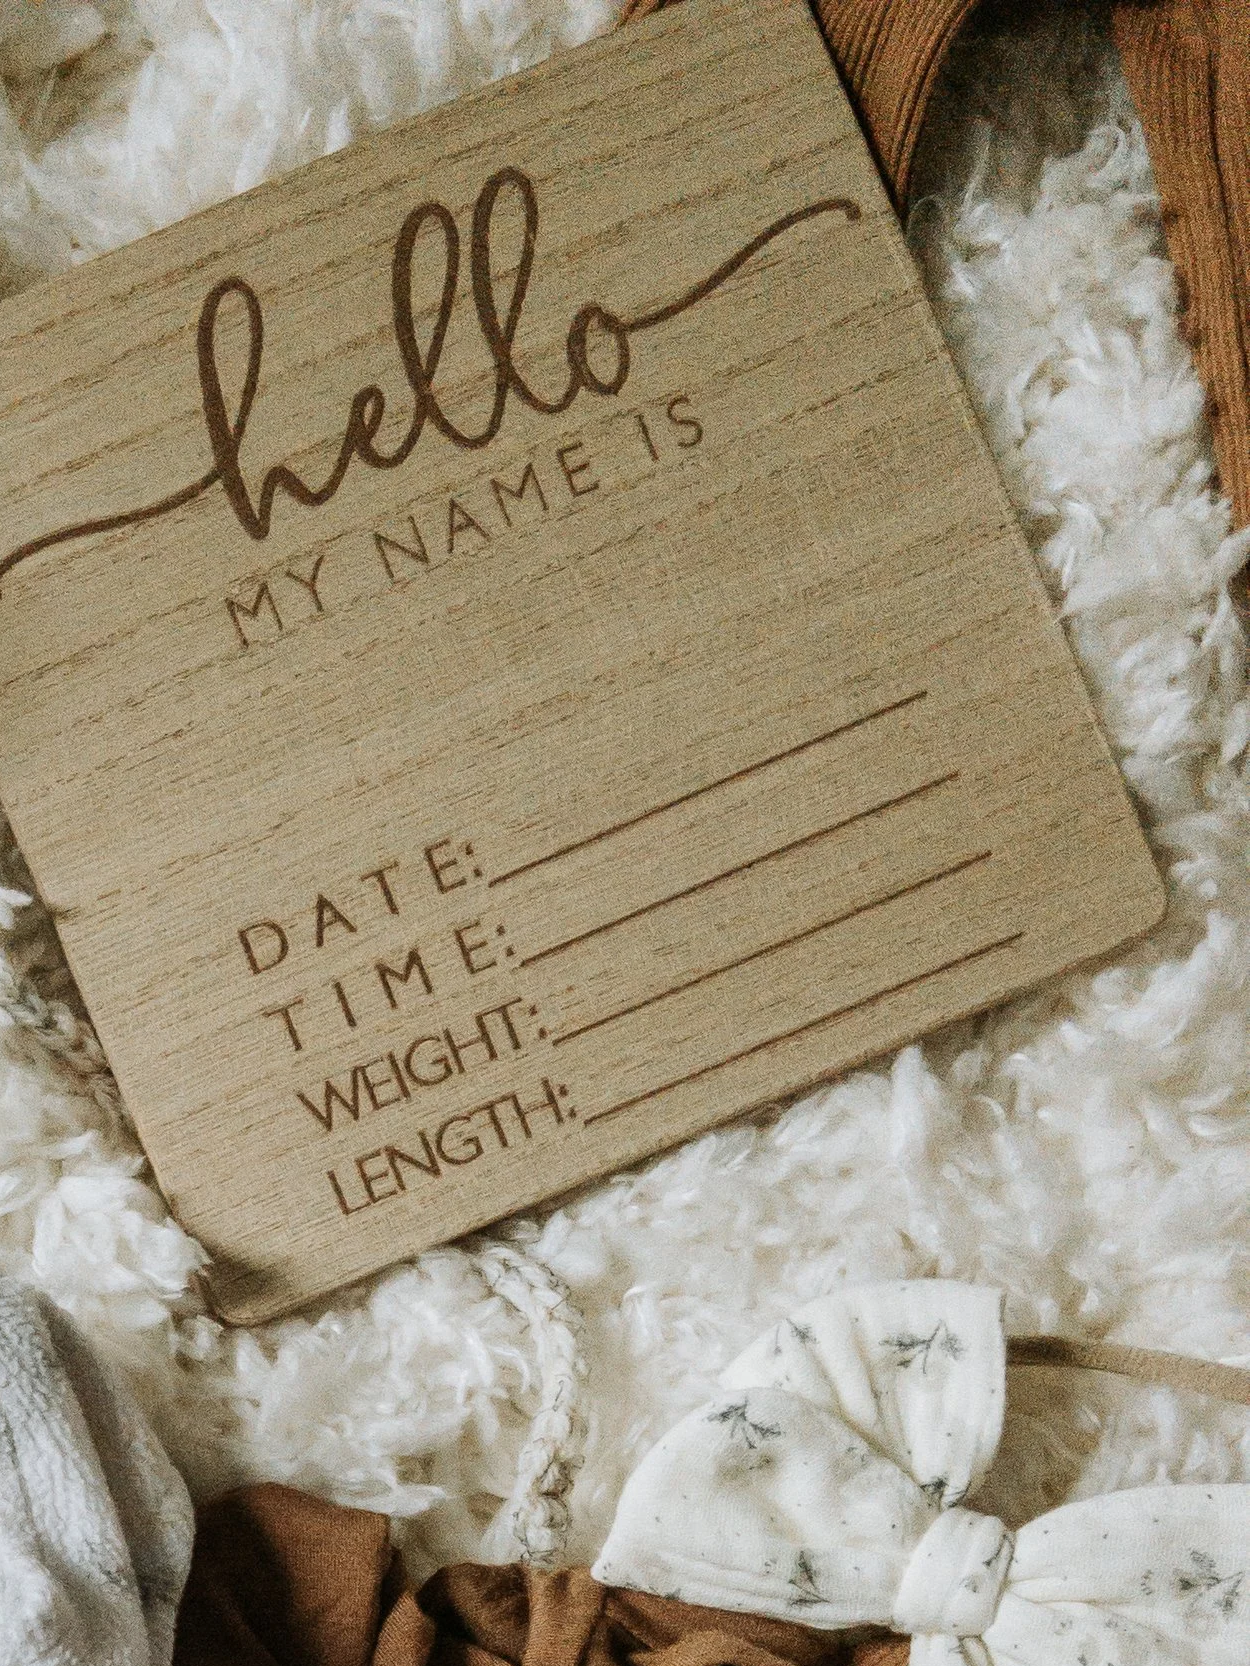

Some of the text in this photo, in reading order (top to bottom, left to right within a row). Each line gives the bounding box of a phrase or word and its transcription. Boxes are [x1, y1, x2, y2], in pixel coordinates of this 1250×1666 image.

[223, 395, 705, 650] MY NAME IS
[237, 837, 483, 976] DATE:
[261, 917, 517, 1052] TIME:
[295, 996, 550, 1134] WEIGHT:
[326, 1076, 579, 1217] LENGTH:
